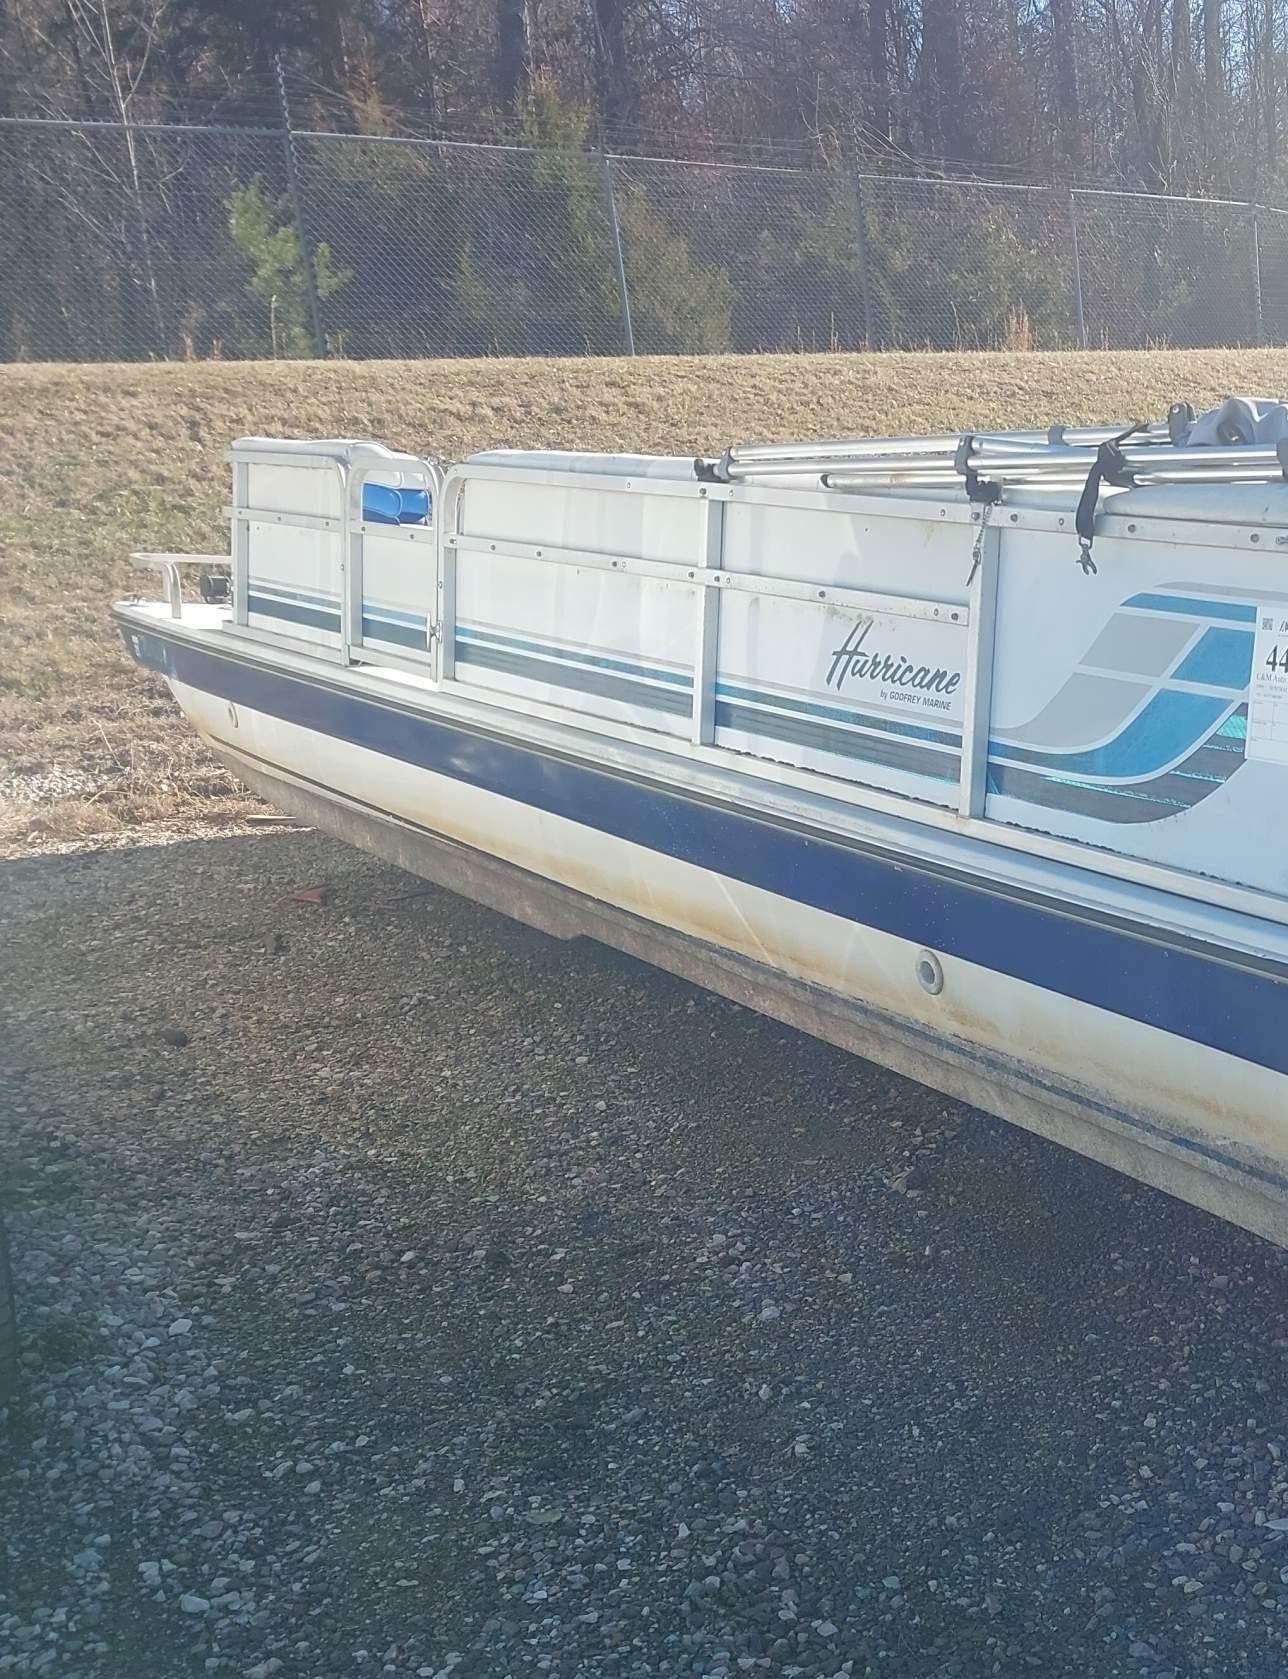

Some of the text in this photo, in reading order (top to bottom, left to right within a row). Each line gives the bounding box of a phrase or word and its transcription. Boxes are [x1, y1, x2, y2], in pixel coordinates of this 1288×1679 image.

[825, 620, 961, 695] Hurricane
[880, 689, 952, 711] by GODFREY MARINE
